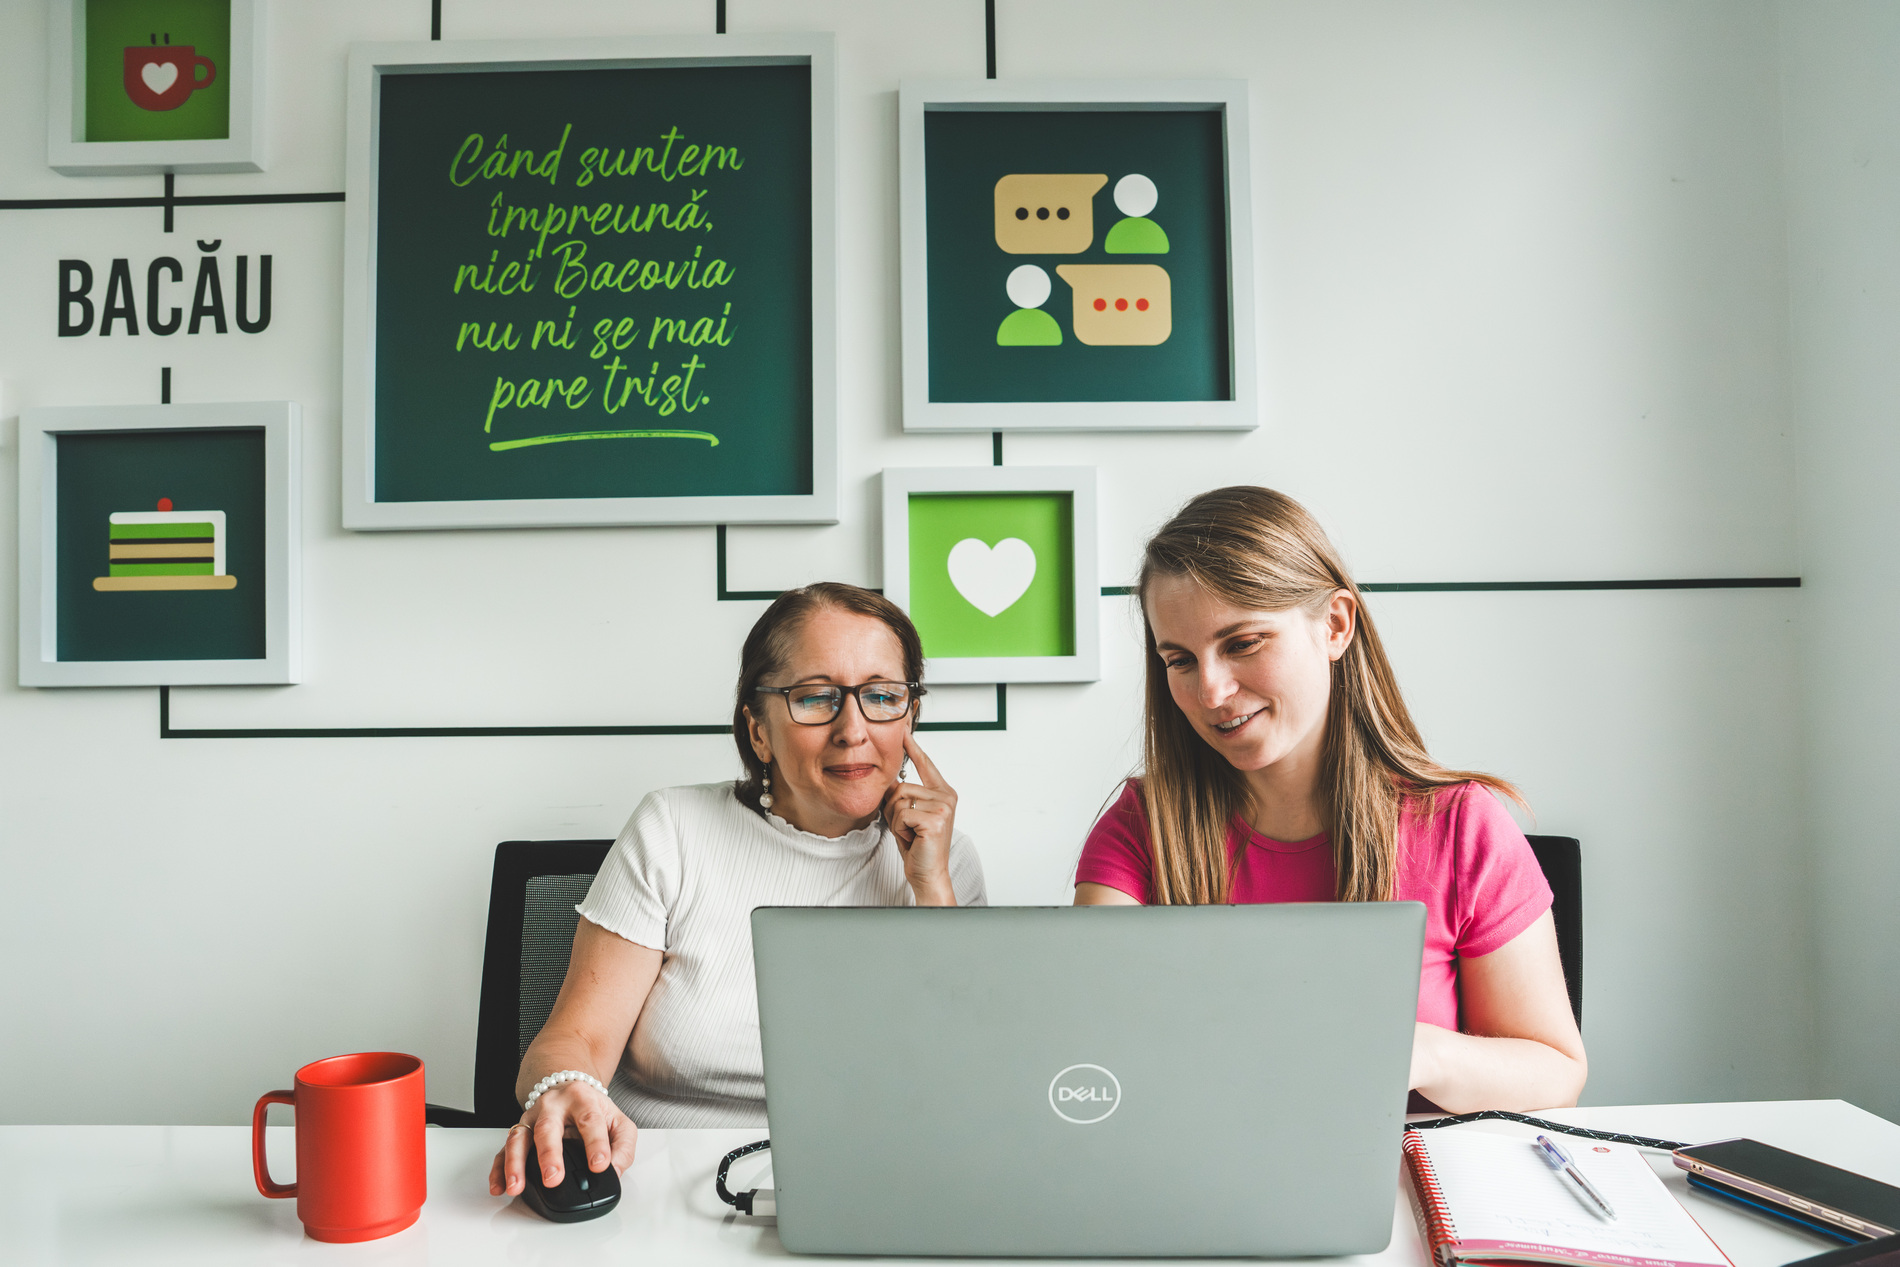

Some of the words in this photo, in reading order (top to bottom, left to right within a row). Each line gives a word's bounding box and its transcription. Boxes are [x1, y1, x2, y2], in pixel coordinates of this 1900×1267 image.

[449, 123, 572, 187] Când
[576, 126, 745, 187] suntem
[487, 189, 713, 258] împreună,
[58, 239, 273, 337] BACĂU
[454, 249, 541, 295] nici
[552, 240, 736, 299] Bacovia
[456, 322, 522, 352] nu
[531, 305, 583, 350] ni
[590, 317, 641, 359] se
[648, 302, 738, 350] mai
[484, 376, 594, 433] pare
[603, 354, 710, 417] trist.
[1058, 1086, 1114, 1103] DELL
